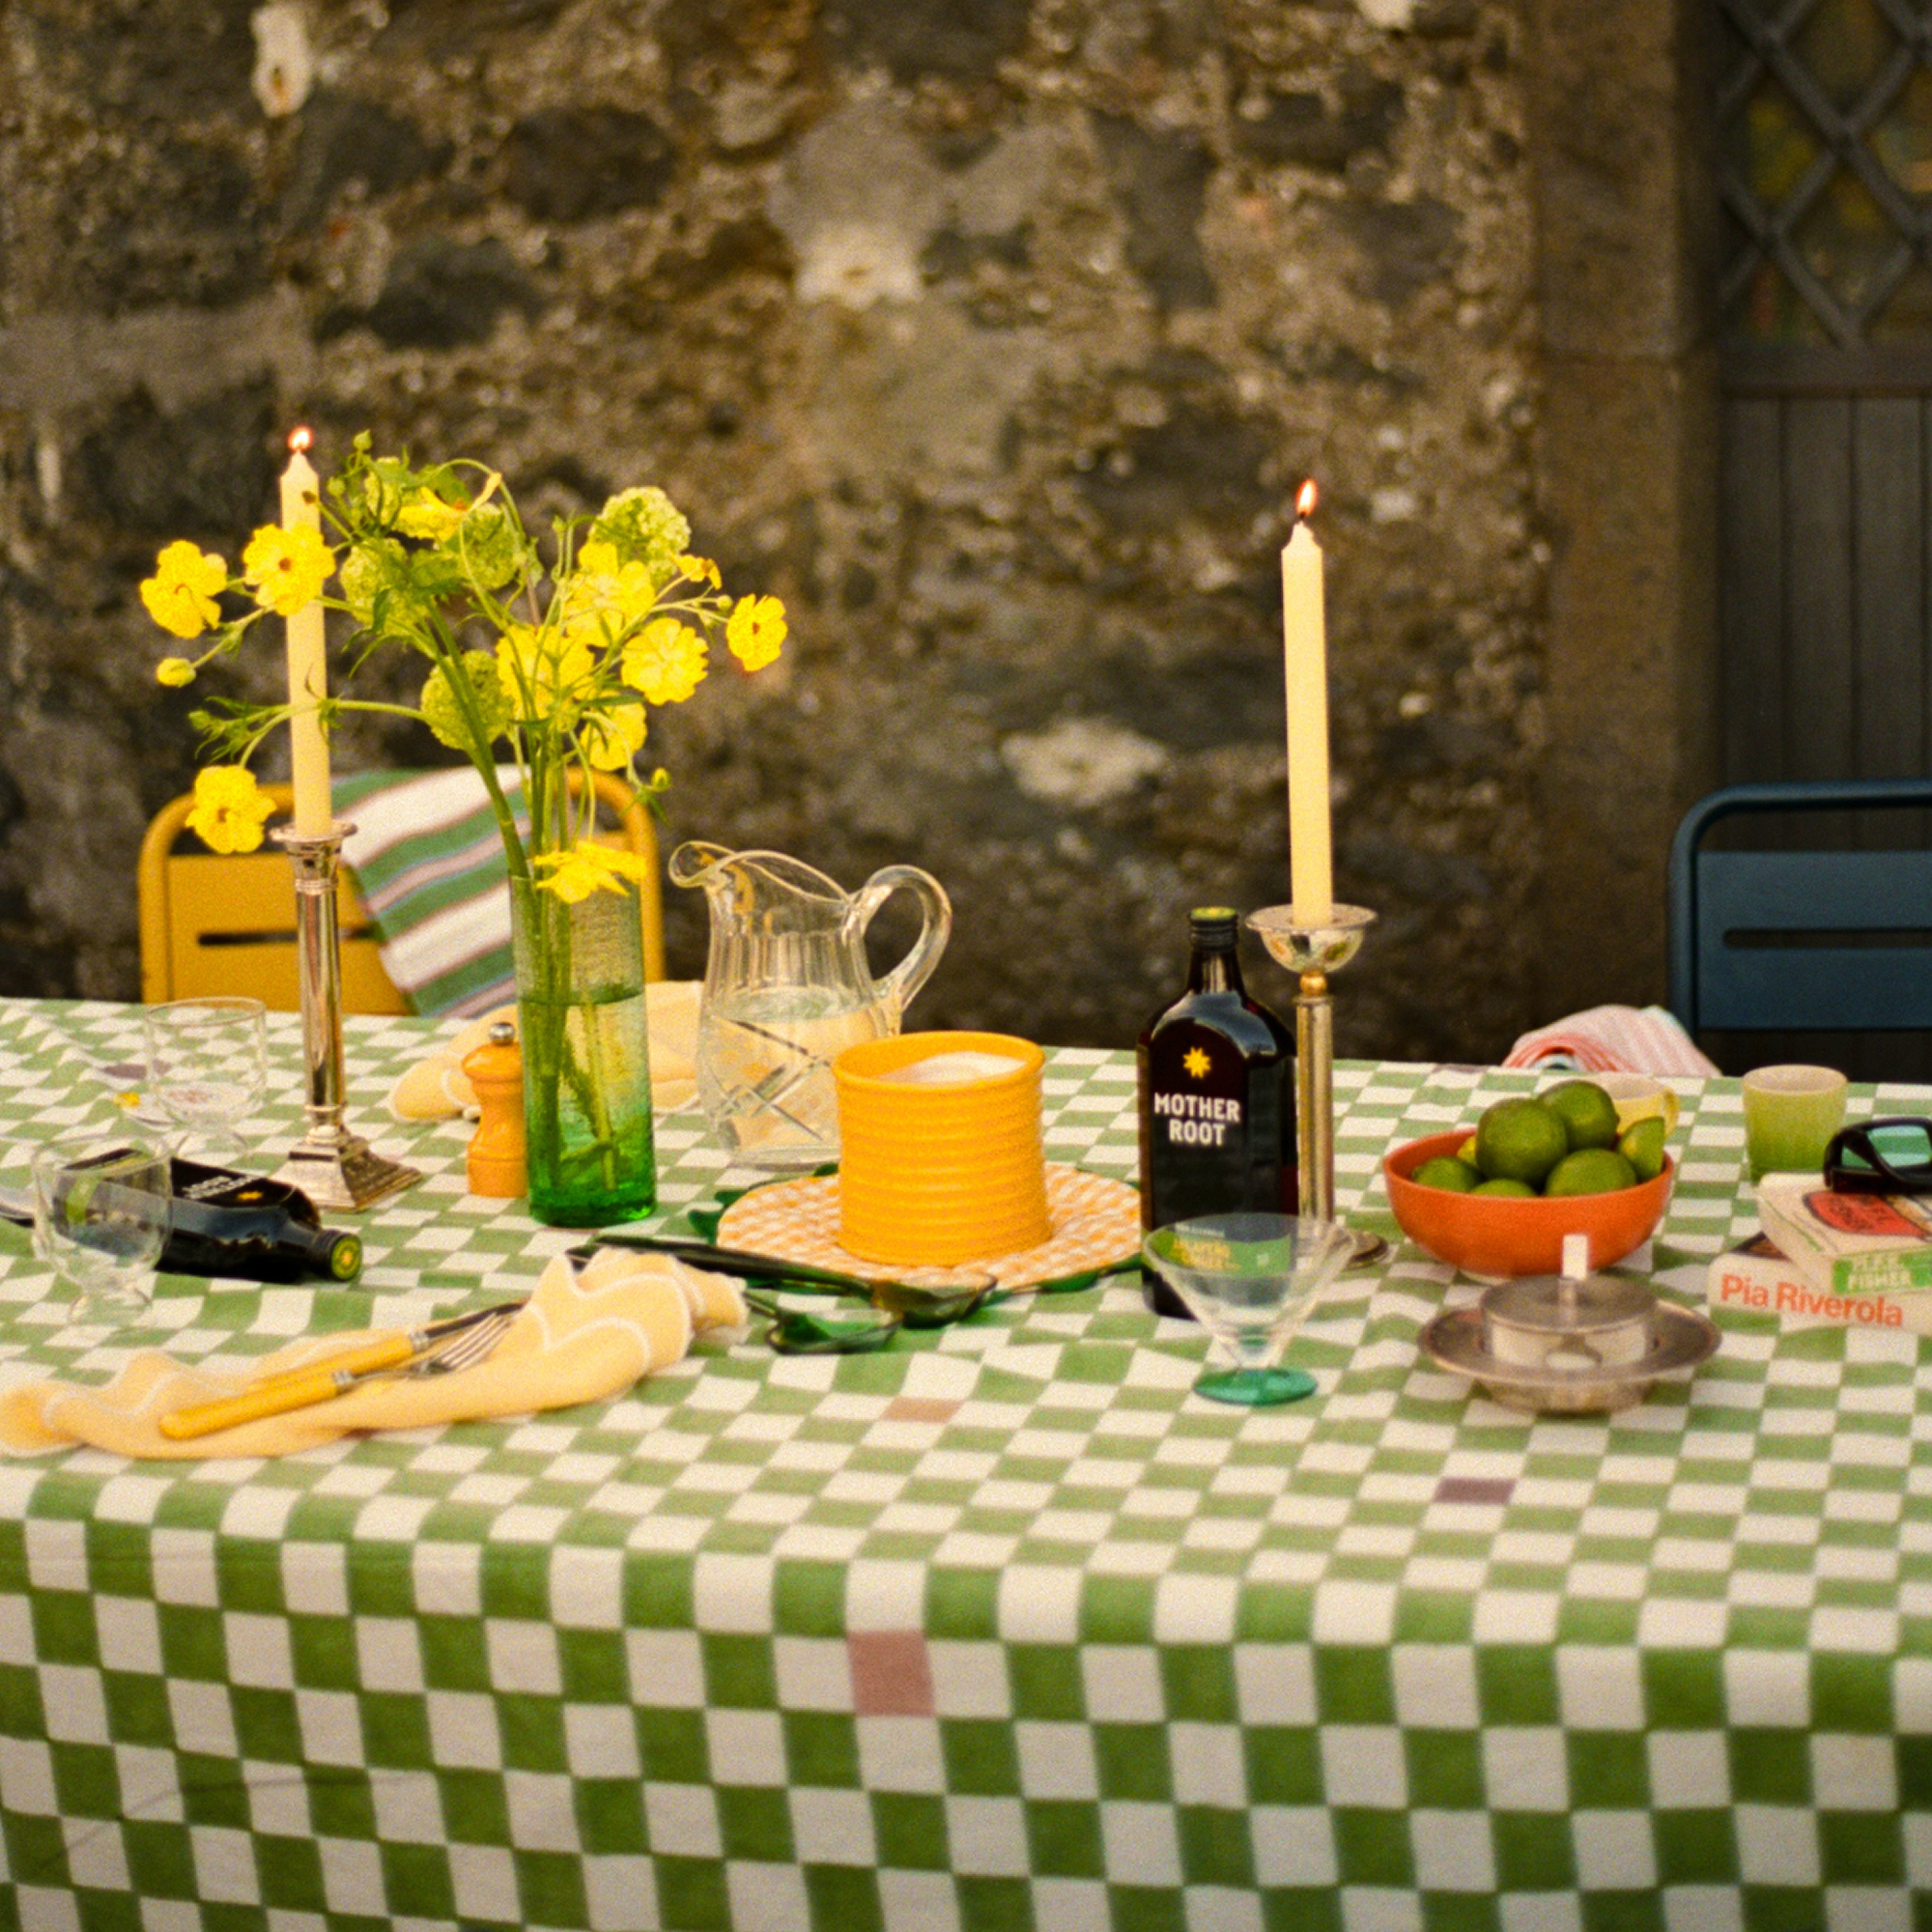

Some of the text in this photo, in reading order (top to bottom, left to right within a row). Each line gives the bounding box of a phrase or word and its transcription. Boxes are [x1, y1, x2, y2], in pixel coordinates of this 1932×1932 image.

[1153, 1093, 1241, 1122] MOTHER
[1169, 1118, 1226, 1147] ROOT
[1720, 1273, 1903, 1327] Pia Riverola
